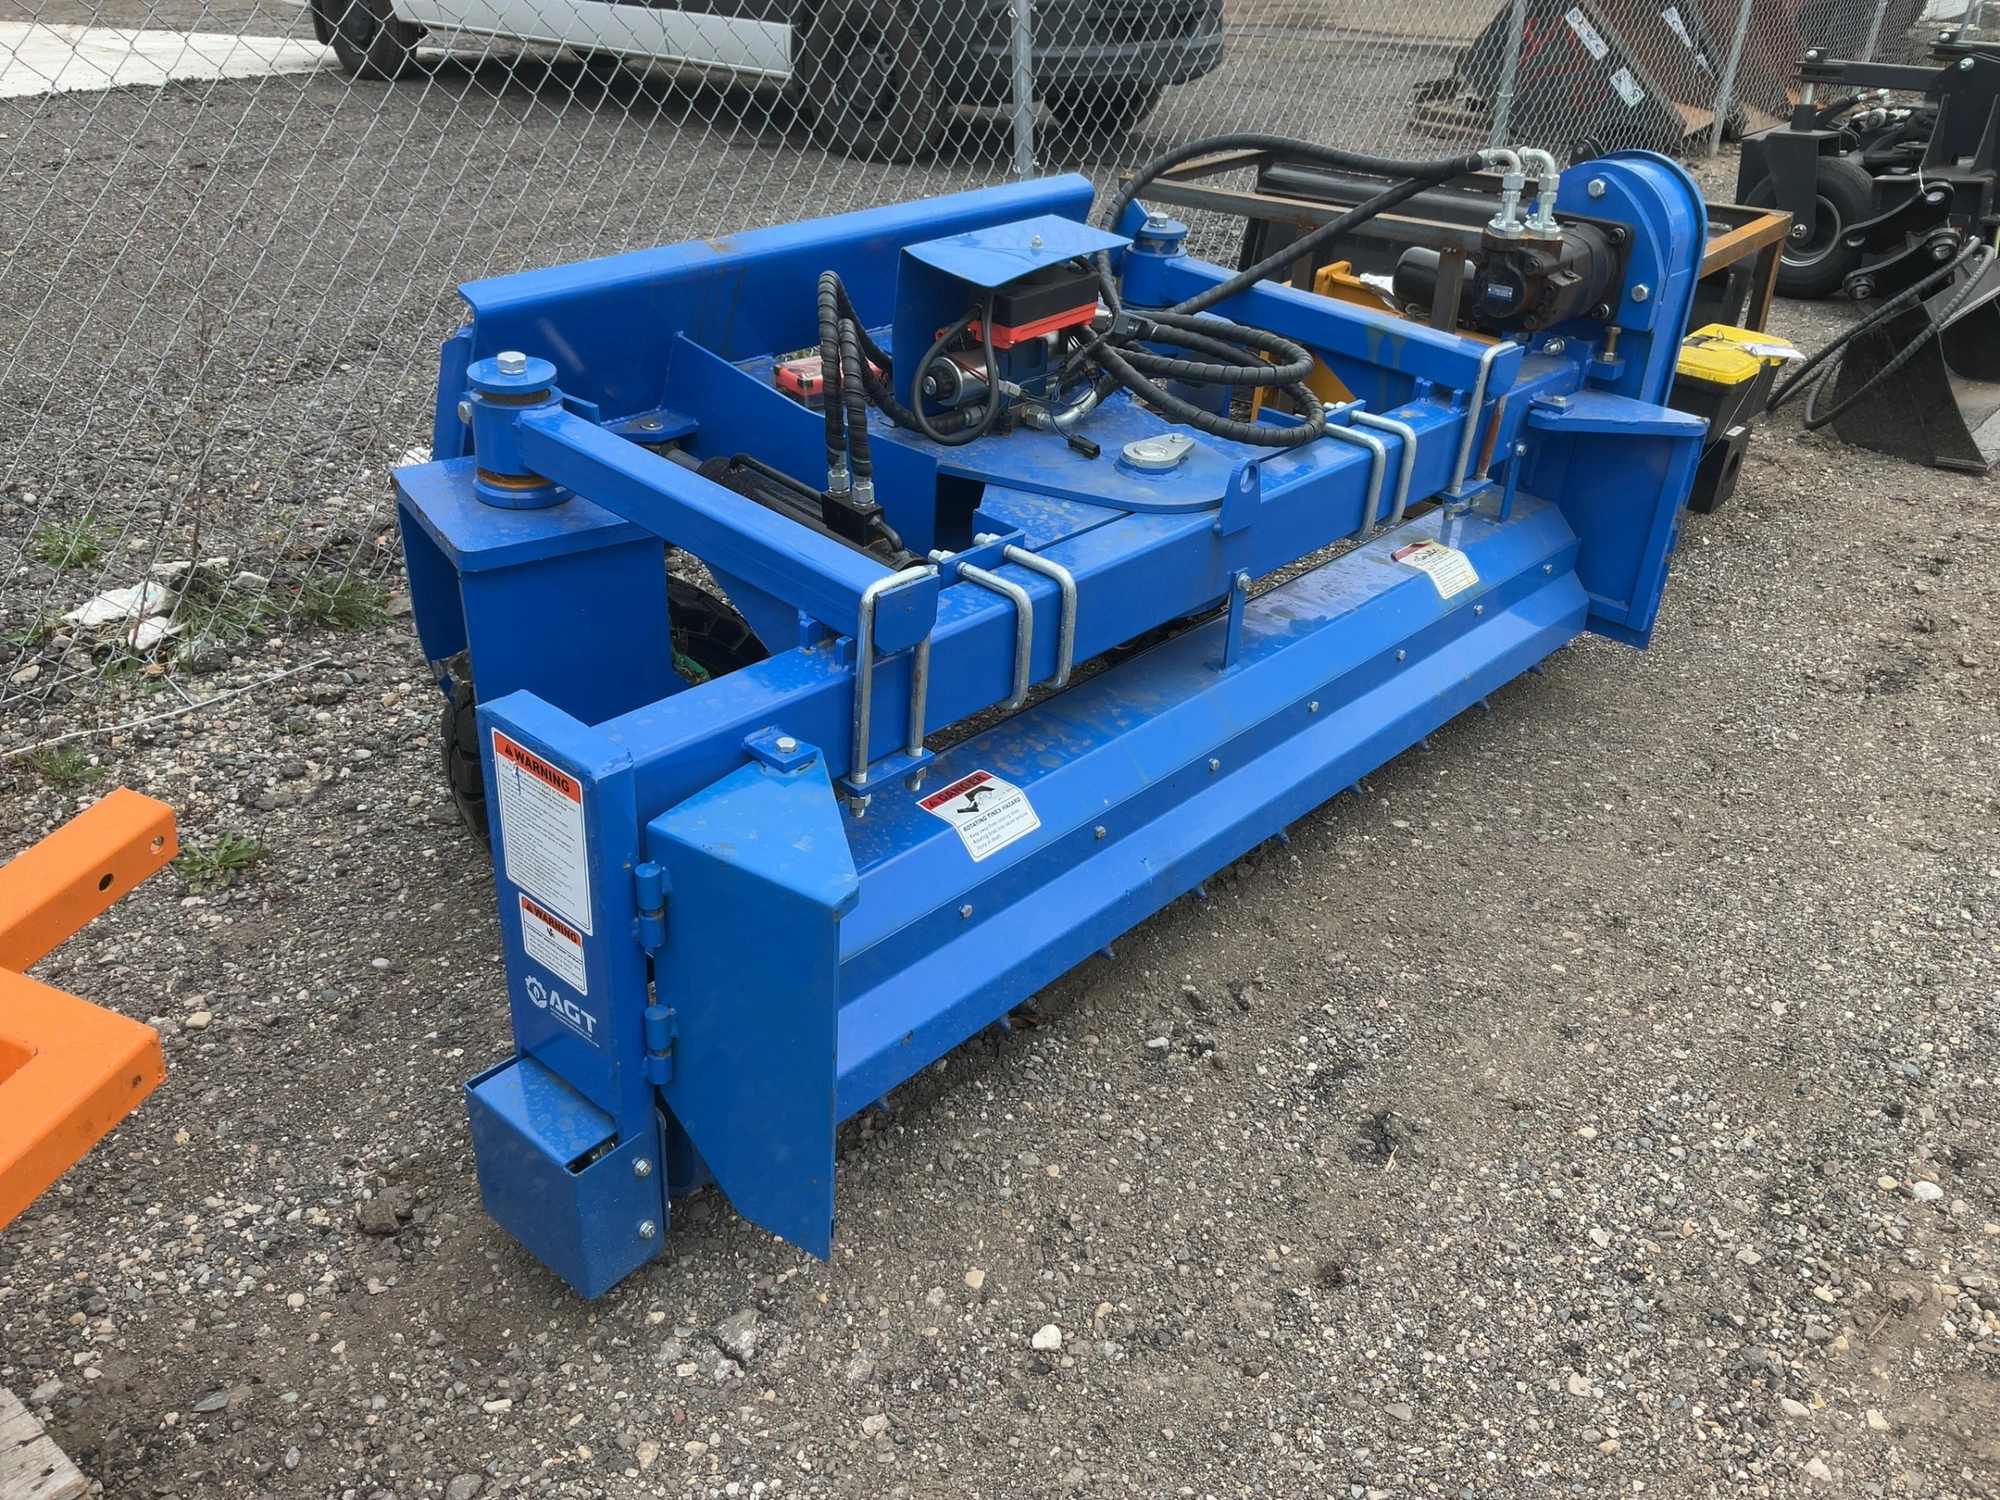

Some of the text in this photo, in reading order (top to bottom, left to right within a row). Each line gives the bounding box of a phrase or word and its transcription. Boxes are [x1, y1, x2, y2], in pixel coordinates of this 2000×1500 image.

[514, 747, 570, 793] WARNING
[938, 775, 985, 802] DANGER
[963, 797, 1021, 832] ROTATING TINES HAZARD
[535, 904, 578, 944] WARNING
[549, 989, 597, 1034] AGT
